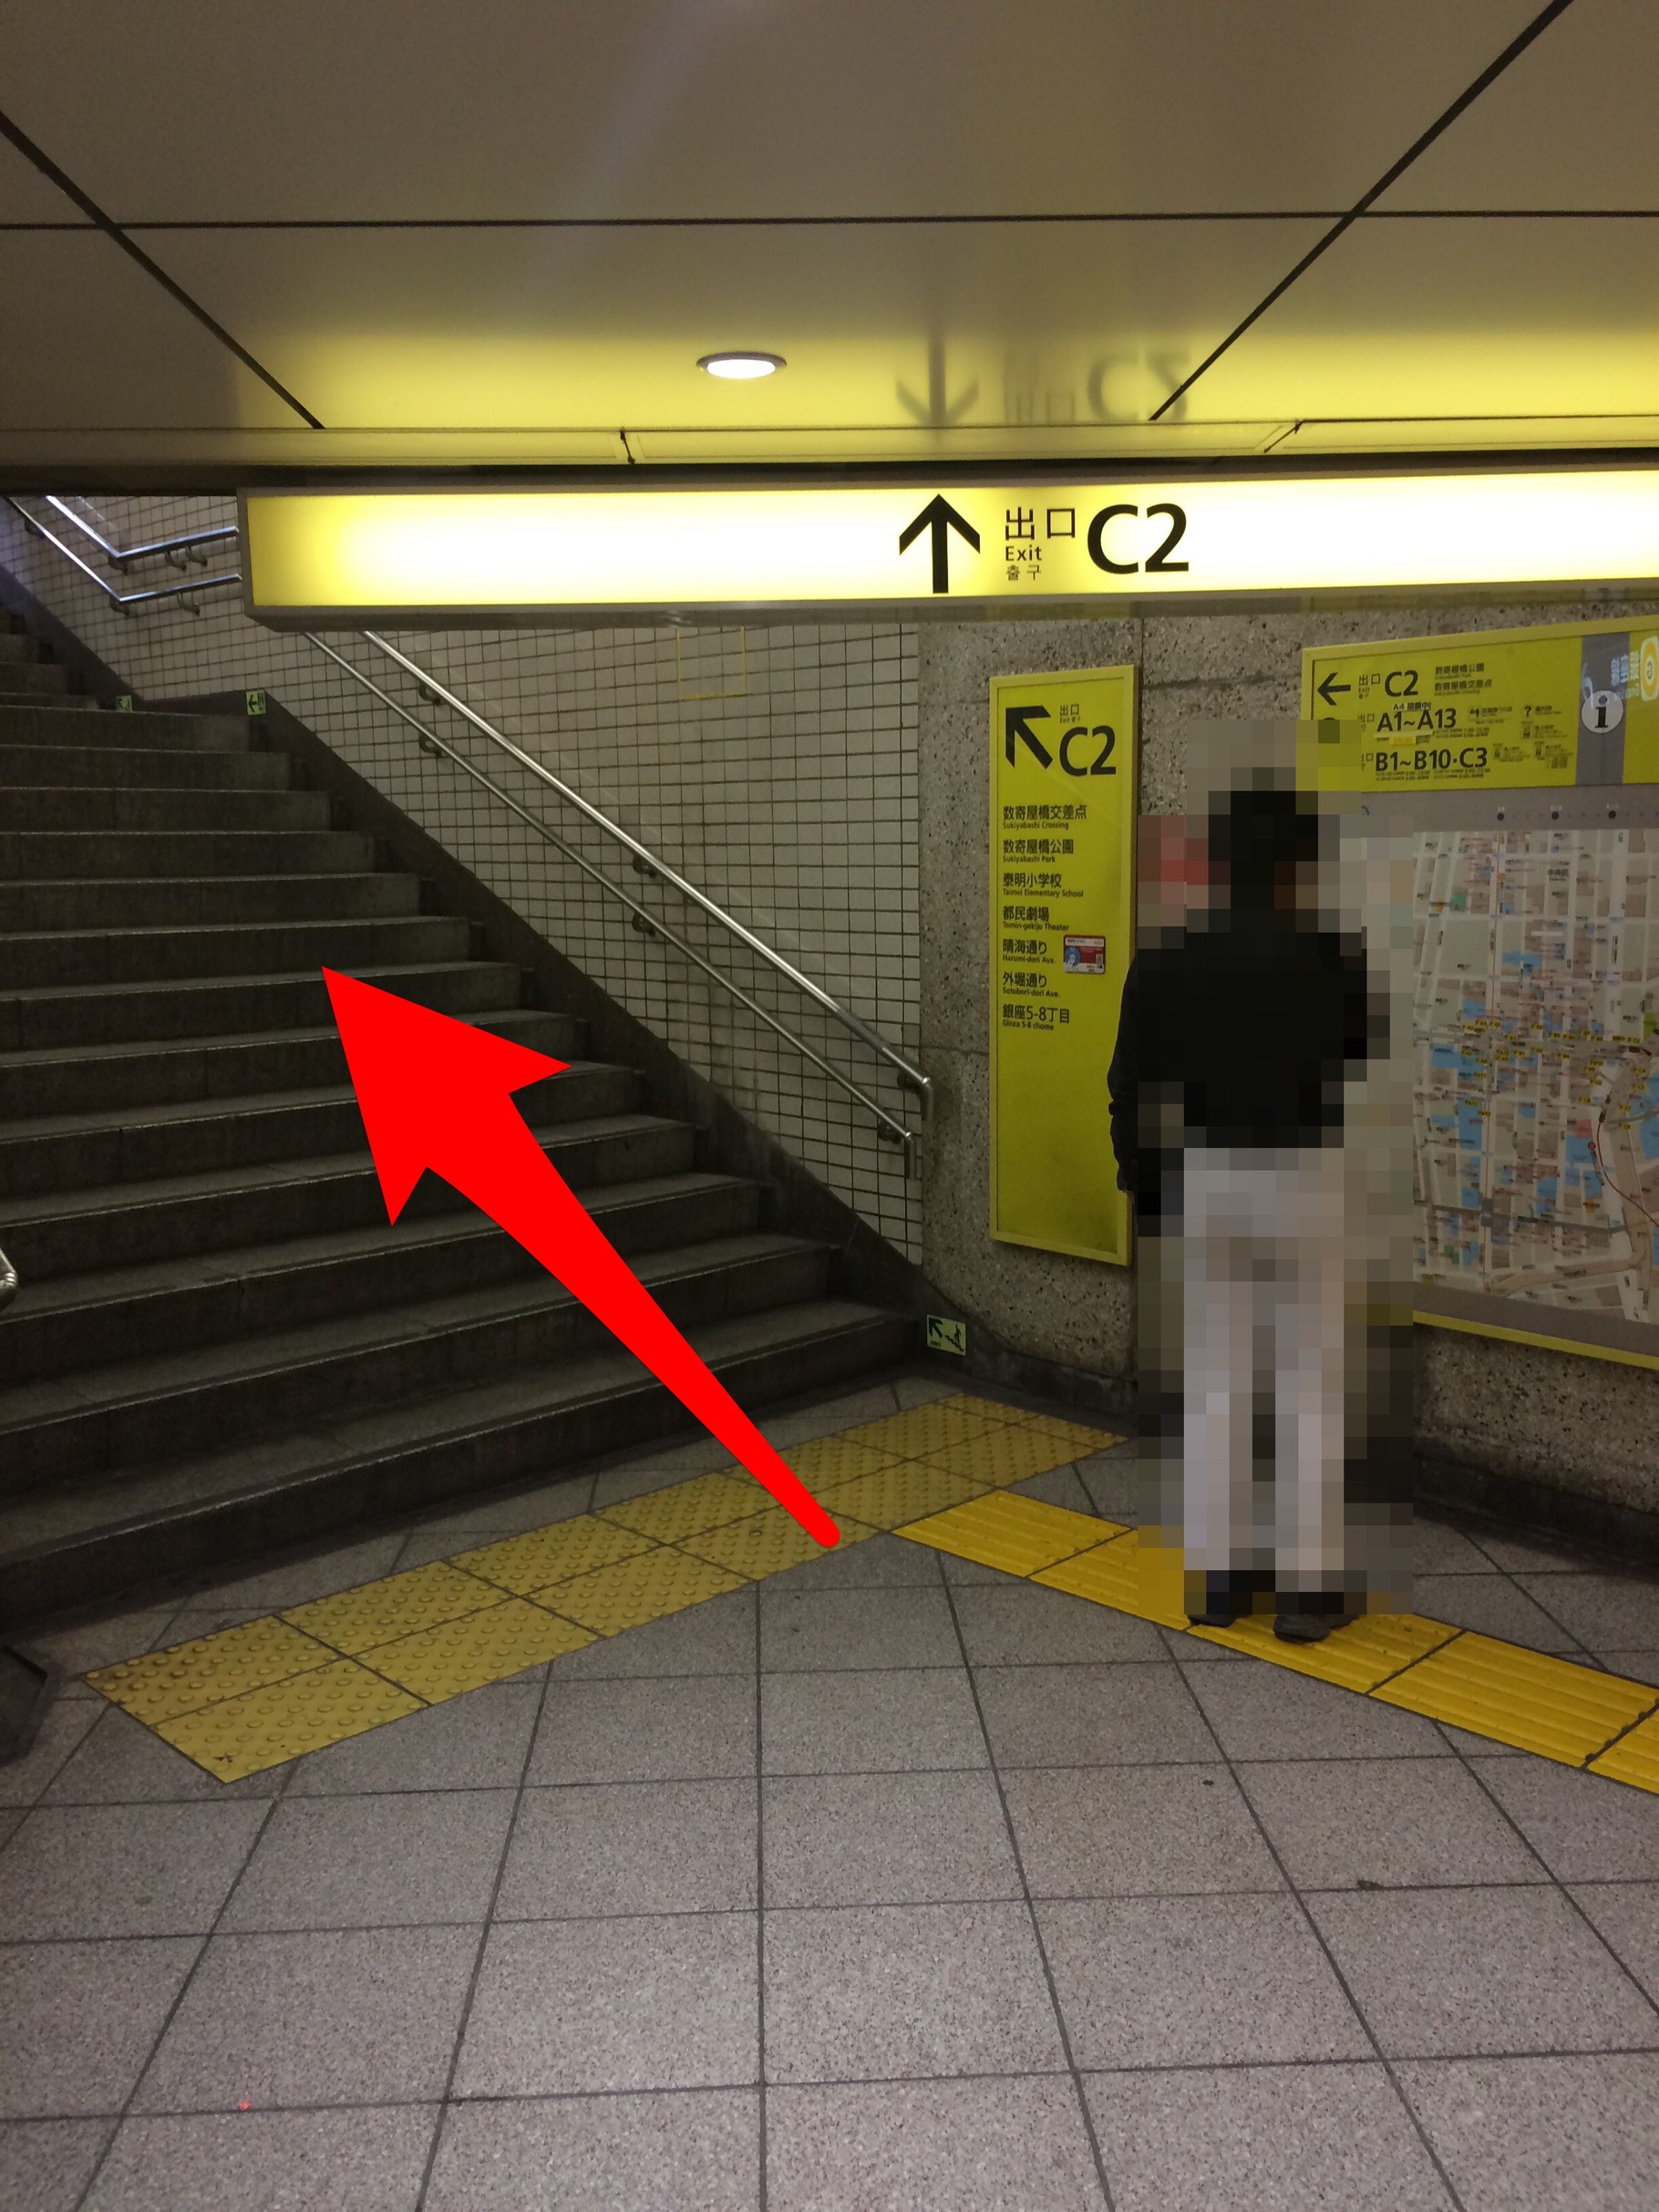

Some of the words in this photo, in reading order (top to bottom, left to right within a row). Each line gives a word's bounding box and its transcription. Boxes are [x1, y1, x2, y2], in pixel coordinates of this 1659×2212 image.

[1005, 507, 1076, 541] 出口
[1087, 503, 1190, 574] C2
[1005, 545, 1042, 562] Exit
[1006, 564, 1042, 581] 출구
[1359, 674, 1381, 686] 出口
[1385, 669, 1418, 697] C2
[1060, 704, 1079, 717] 出口
[1059, 726, 1117, 777] C2
[1003, 804, 1087, 821] 数寄屋橋交差点
[1003, 822, 1040, 831] Sukiyabashi
[1042, 822, 1069, 831] Crossing
[1003, 839, 1075, 855] 数寄屋橋公園
[1003, 855, 1040, 864] Sukiyabashi
[1003, 873, 1062, 888] 泰明小学校
[1025, 889, 1059, 899] Elementary
[1062, 890, 1084, 898] School
[1003, 905, 1050, 923] 都民劇場
[1045, 923, 1070, 932] Theater
[1003, 939, 1047, 955] 晴海通り
[1003, 971, 1047, 987] 外堀通り
[1003, 987, 1045, 997] Sotobori-dori
[1003, 1004, 1070, 1024] 銀座5-8丁目
[1003, 1019, 1020, 1028] Ginza
[1033, 1021, 1054, 1031] chome
